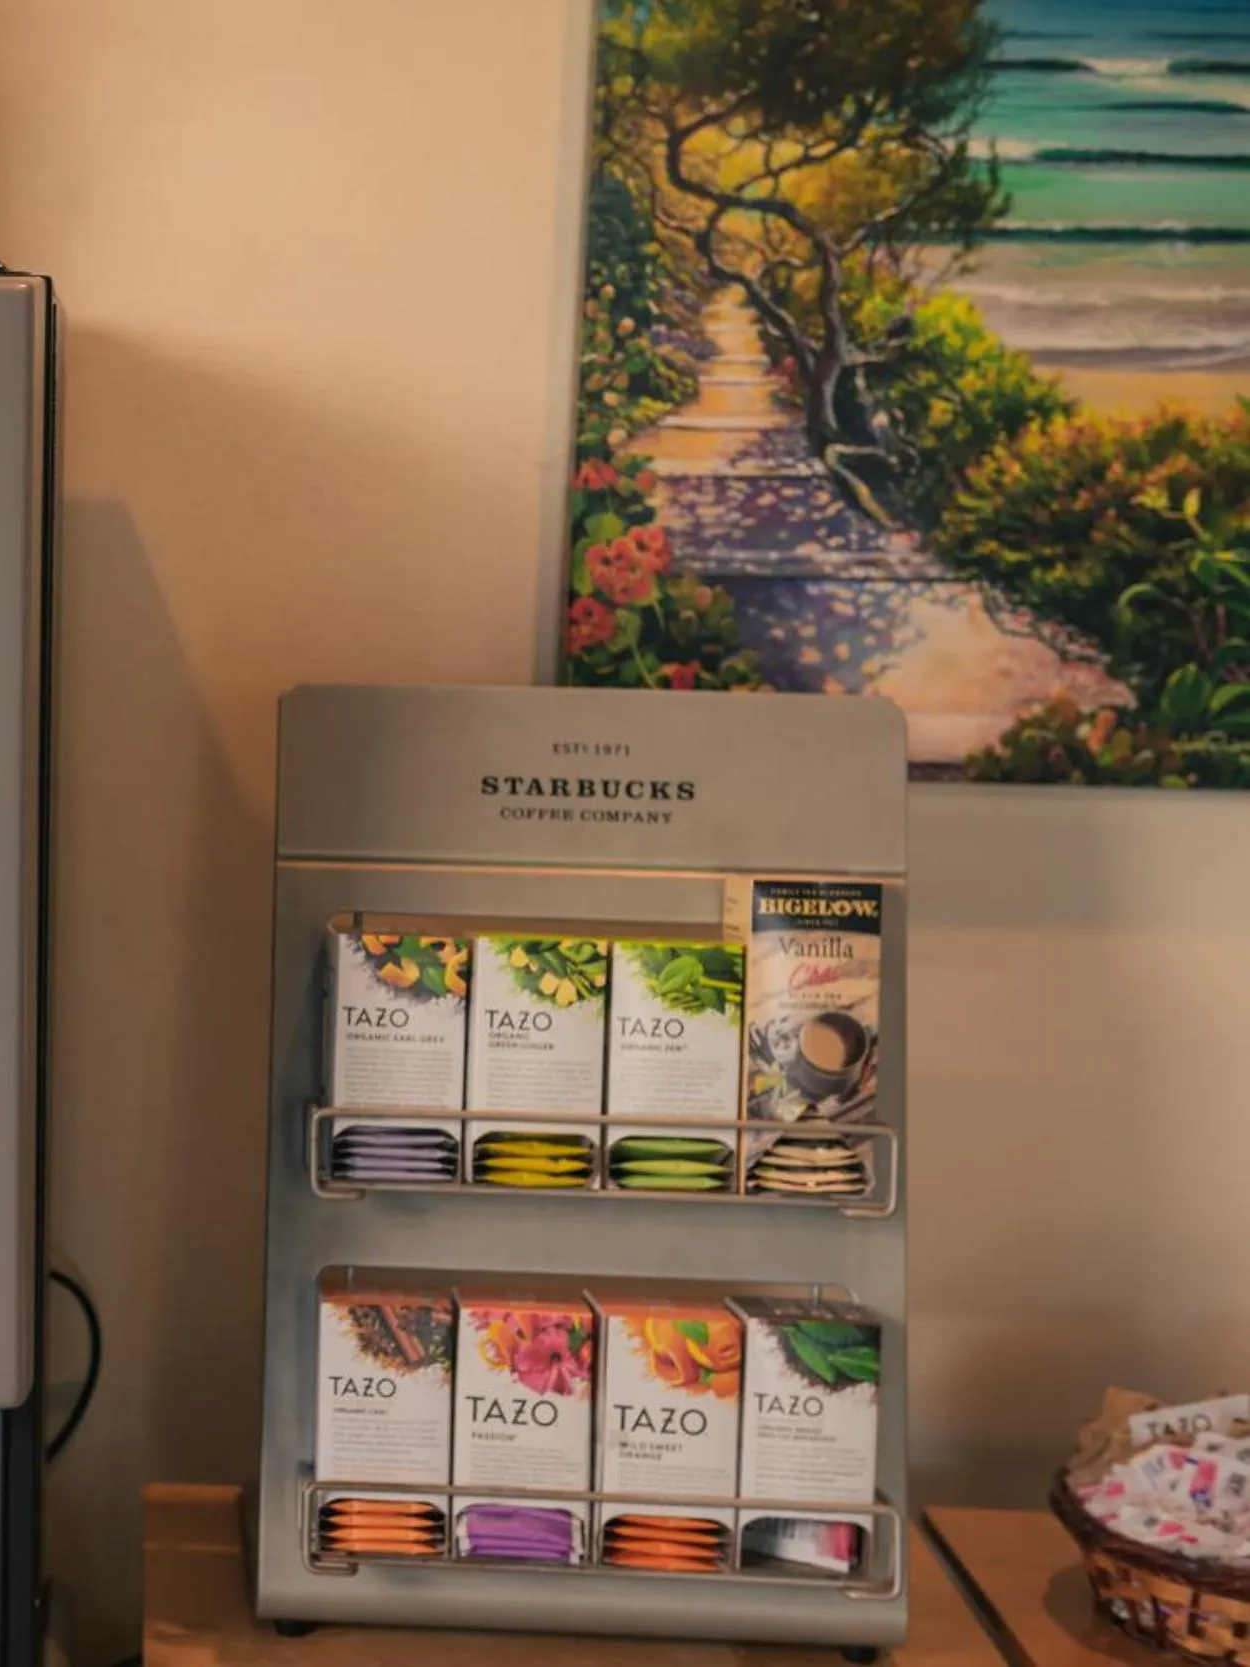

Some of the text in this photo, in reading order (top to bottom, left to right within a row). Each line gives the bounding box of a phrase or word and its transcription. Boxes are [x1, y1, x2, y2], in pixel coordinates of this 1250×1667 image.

[594, 743, 631, 757] 1971
[480, 775, 696, 801] STARBUCKS
[499, 807, 674, 825] COFFEE COMPANY
[758, 897, 877, 917] BIGELOW
[778, 936, 854, 959] Vanilla
[342, 1005, 410, 1028] TAZO
[484, 1009, 553, 1032] TAZO
[616, 1016, 685, 1039] TAZO
[328, 1376, 397, 1398] TAZO
[465, 1395, 559, 1427] TAZO
[753, 1391, 825, 1417] TAZO
[612, 1404, 708, 1437] TAZO
